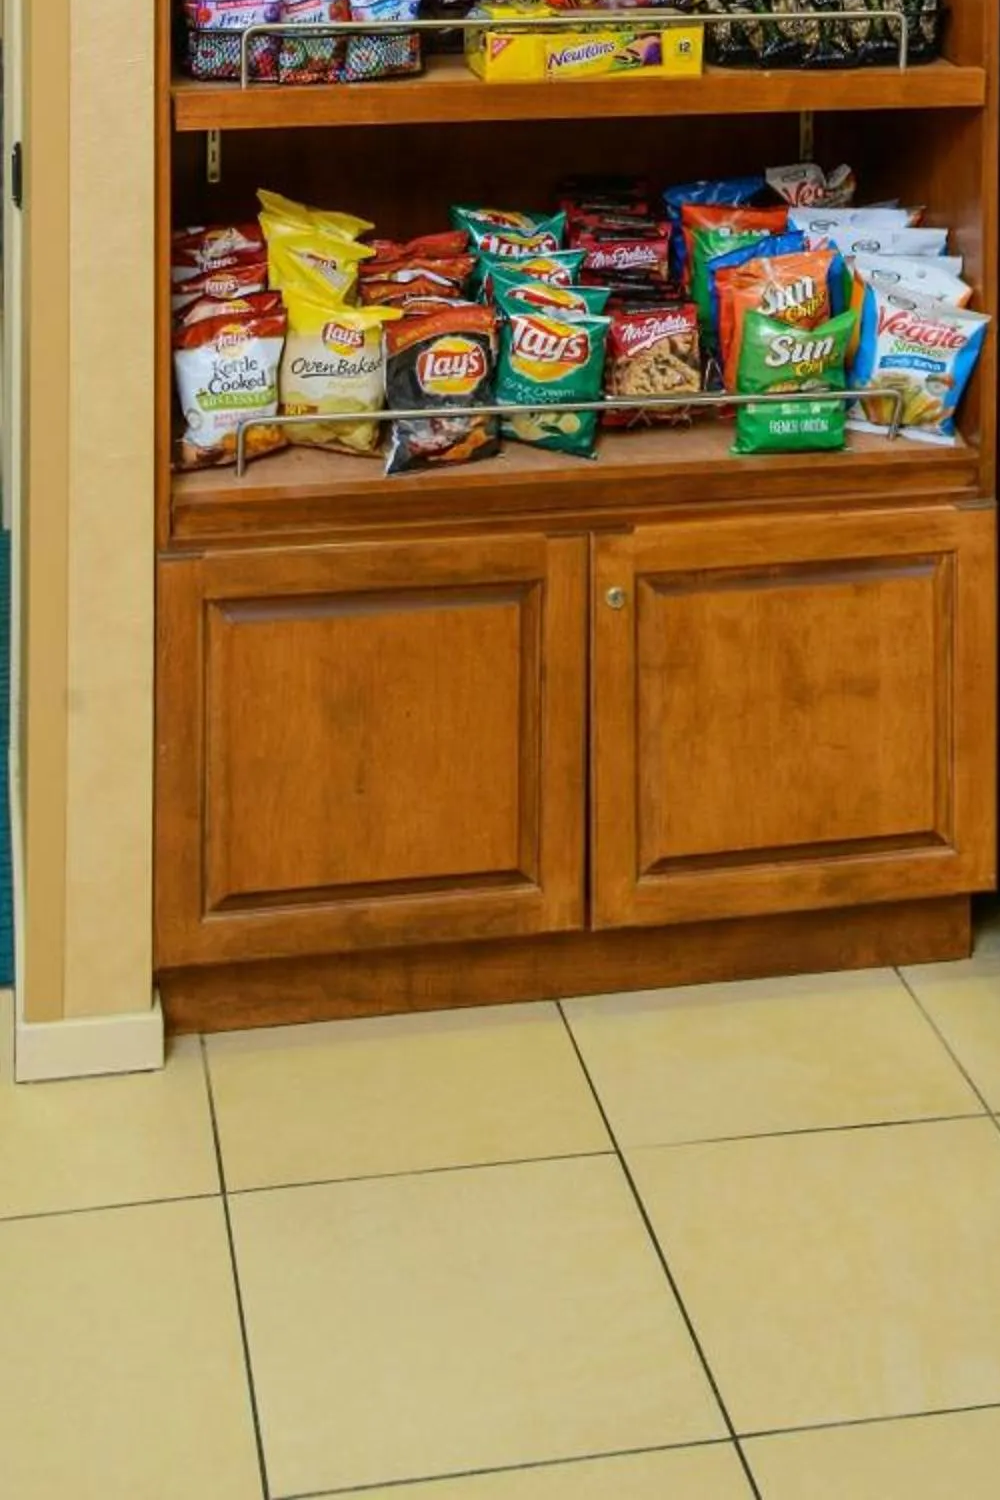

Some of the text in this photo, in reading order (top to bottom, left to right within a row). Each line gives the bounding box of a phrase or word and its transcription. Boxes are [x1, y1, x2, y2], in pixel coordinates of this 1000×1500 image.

[548, 40, 616, 71] Newtons
[878, 305, 967, 349] Veggie
[291, 357, 335, 375] Oven
[765, 336, 834, 367] Sun
[208, 369, 266, 397] Cooked
